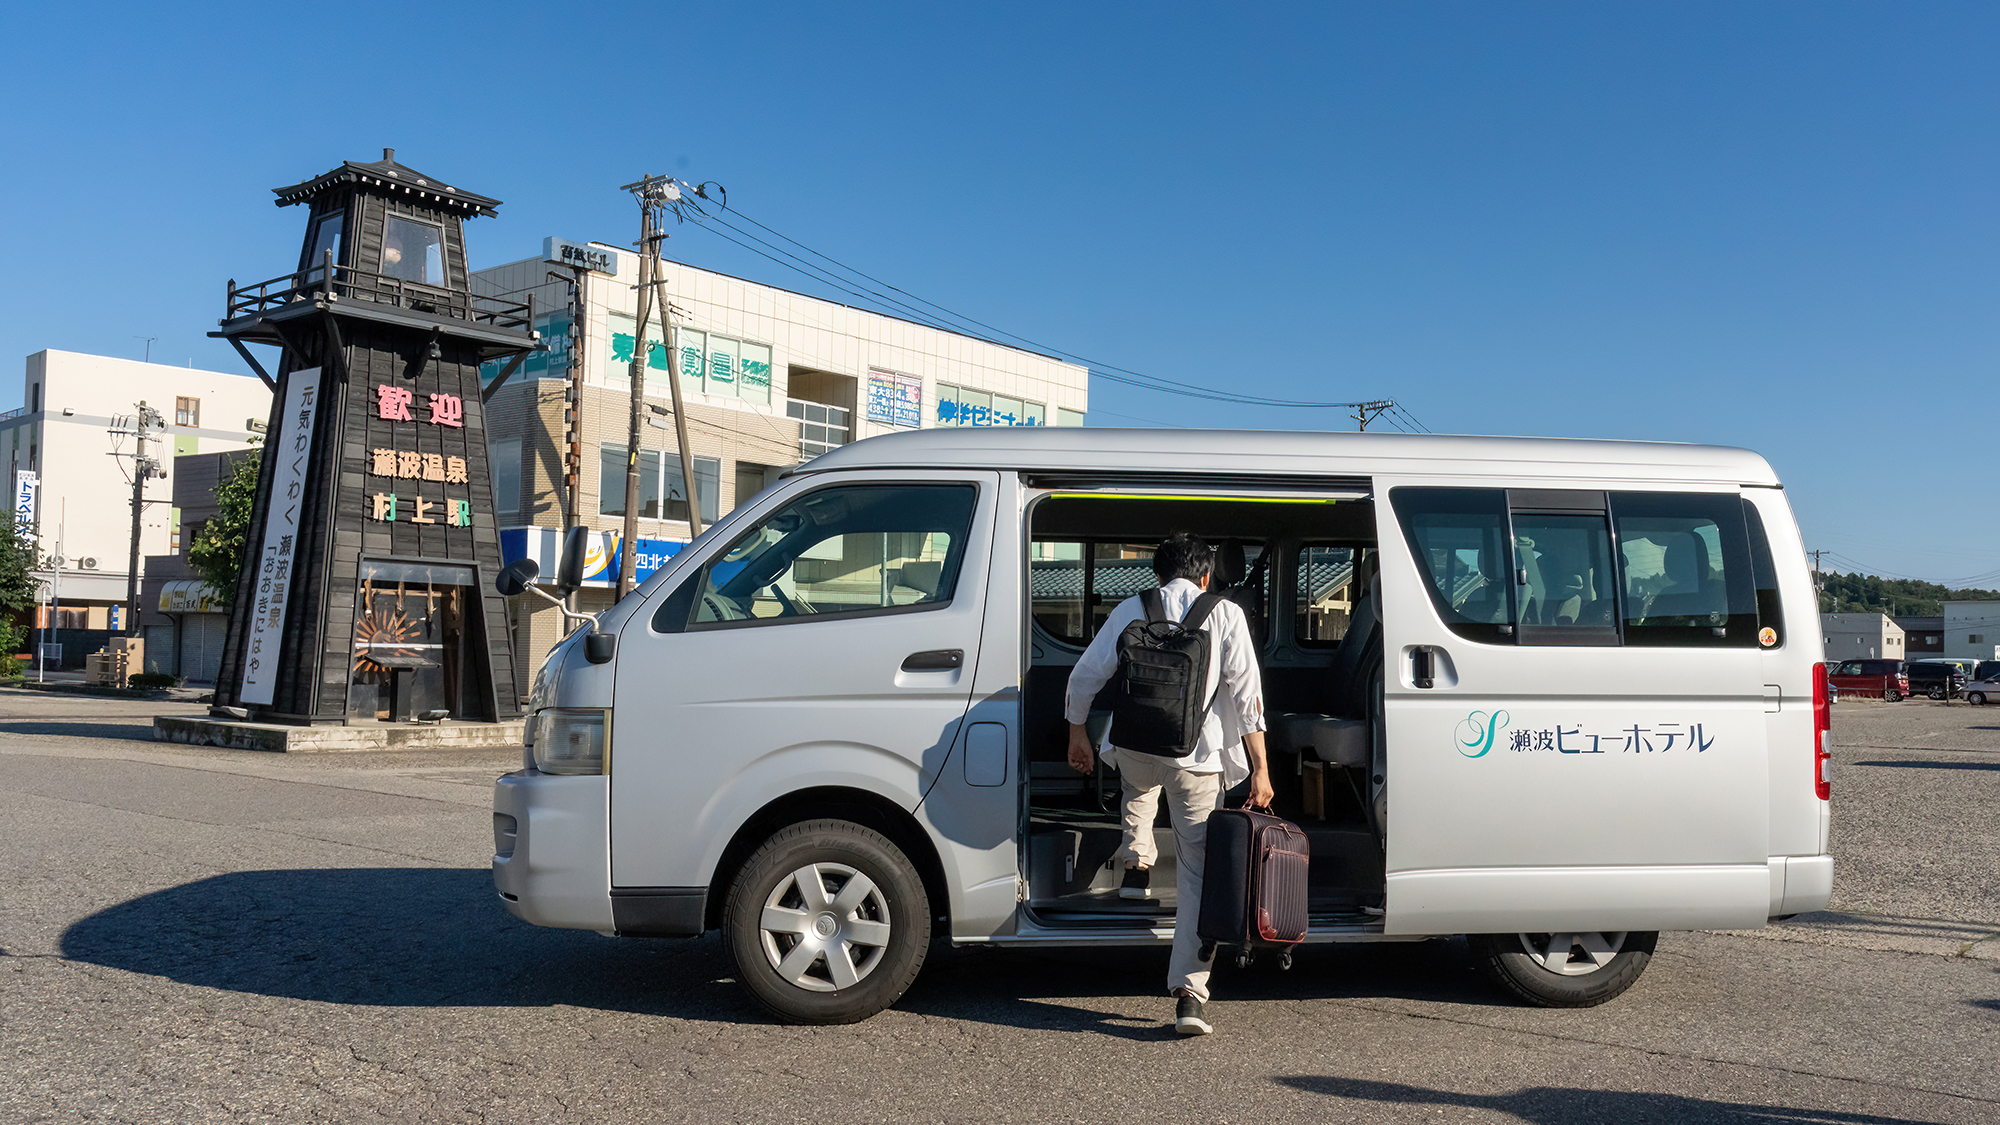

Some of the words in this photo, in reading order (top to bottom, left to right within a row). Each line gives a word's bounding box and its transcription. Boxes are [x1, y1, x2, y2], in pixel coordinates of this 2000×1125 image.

[378, 384, 463, 428] 歓迎
[284, 385, 314, 526] 元気わくわく
[373, 448, 469, 484] 瀬波温泉
[372, 492, 470, 527] 村上駅
[1508, 723, 1716, 755] 瀬波ビューホテル
